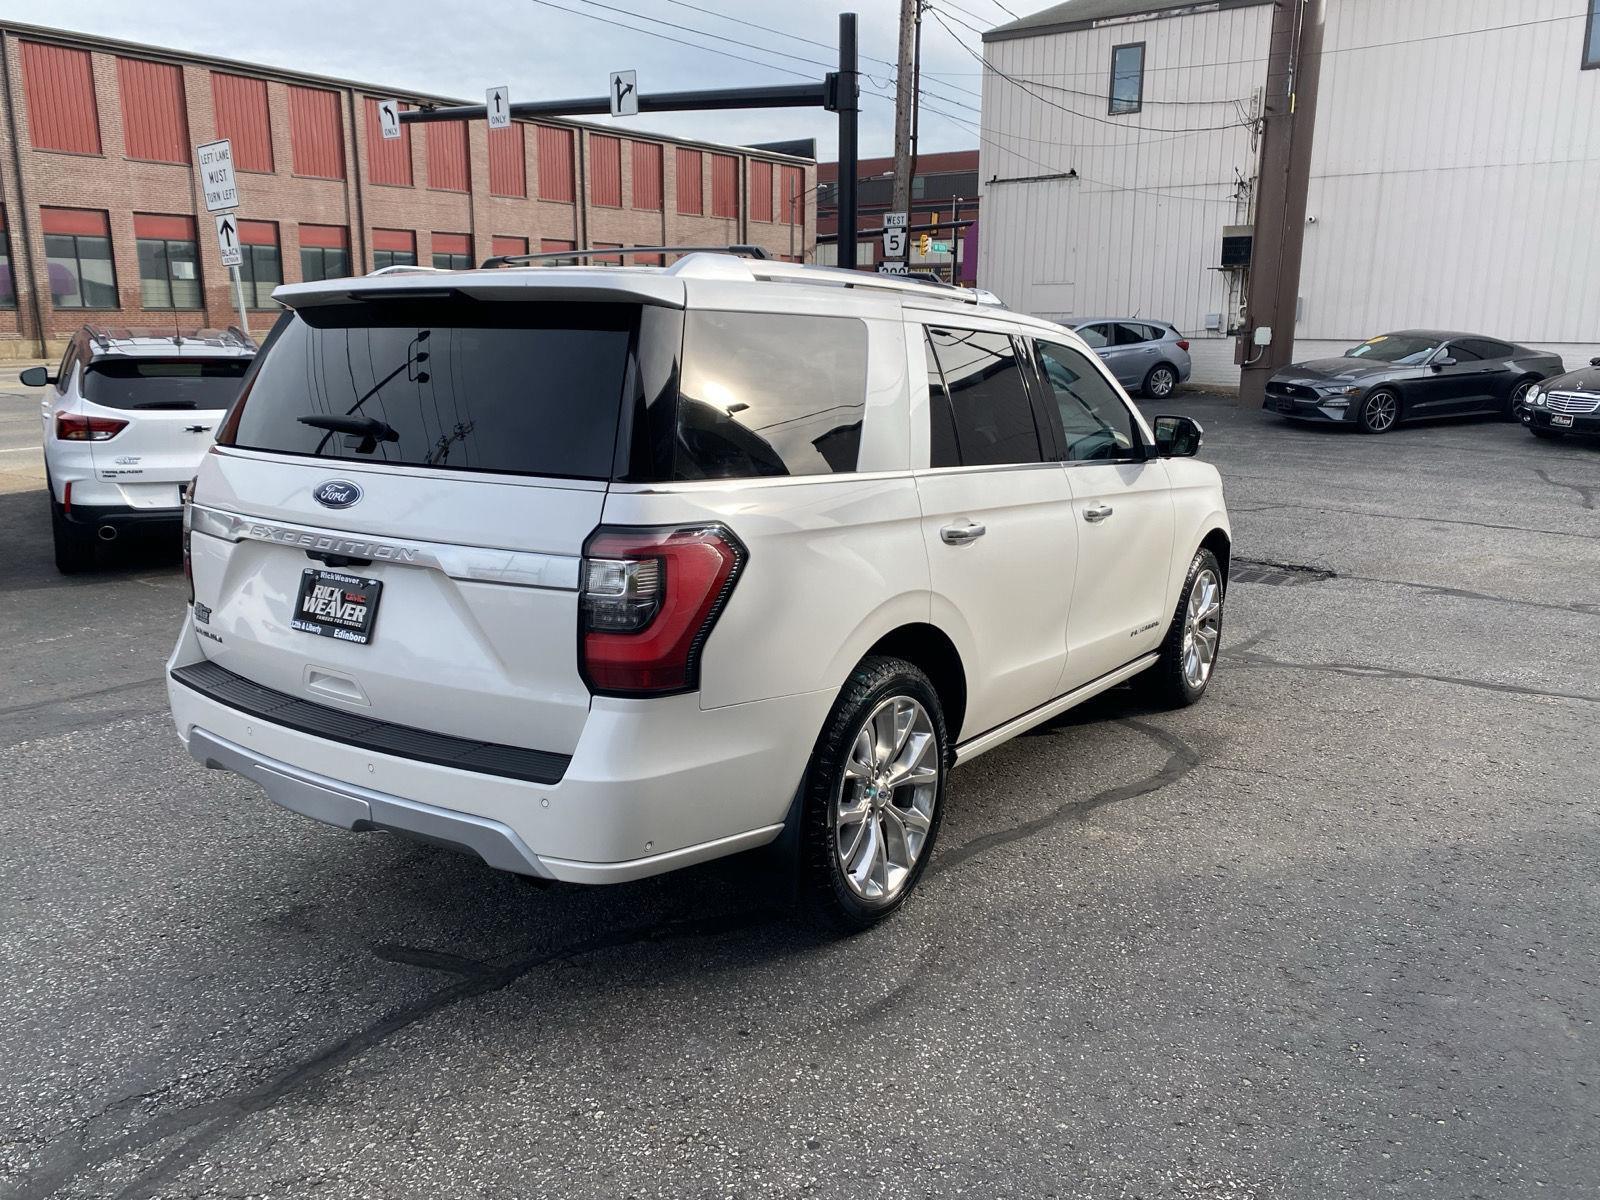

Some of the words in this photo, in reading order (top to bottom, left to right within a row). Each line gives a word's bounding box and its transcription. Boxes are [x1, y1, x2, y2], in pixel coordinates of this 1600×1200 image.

[491, 115, 507, 124] ONLY
[384, 128, 398, 136] ONLY
[201, 152, 214, 165] LEFT
[215, 149, 229, 162] LANE
[208, 169, 227, 183] MUST
[207, 191, 221, 203] TURN
[222, 188, 235, 200] LEFT
[886, 215, 905, 225] WEST
[889, 235, 900, 251] 5
[221, 248, 239, 257] BLACK
[320, 484, 350, 502] Ford
[250, 525, 419, 561] EXPEDITION
[312, 584, 344, 601] RICK
[302, 596, 368, 622] WEAVER
[333, 628, 367, 644] Edinboro
